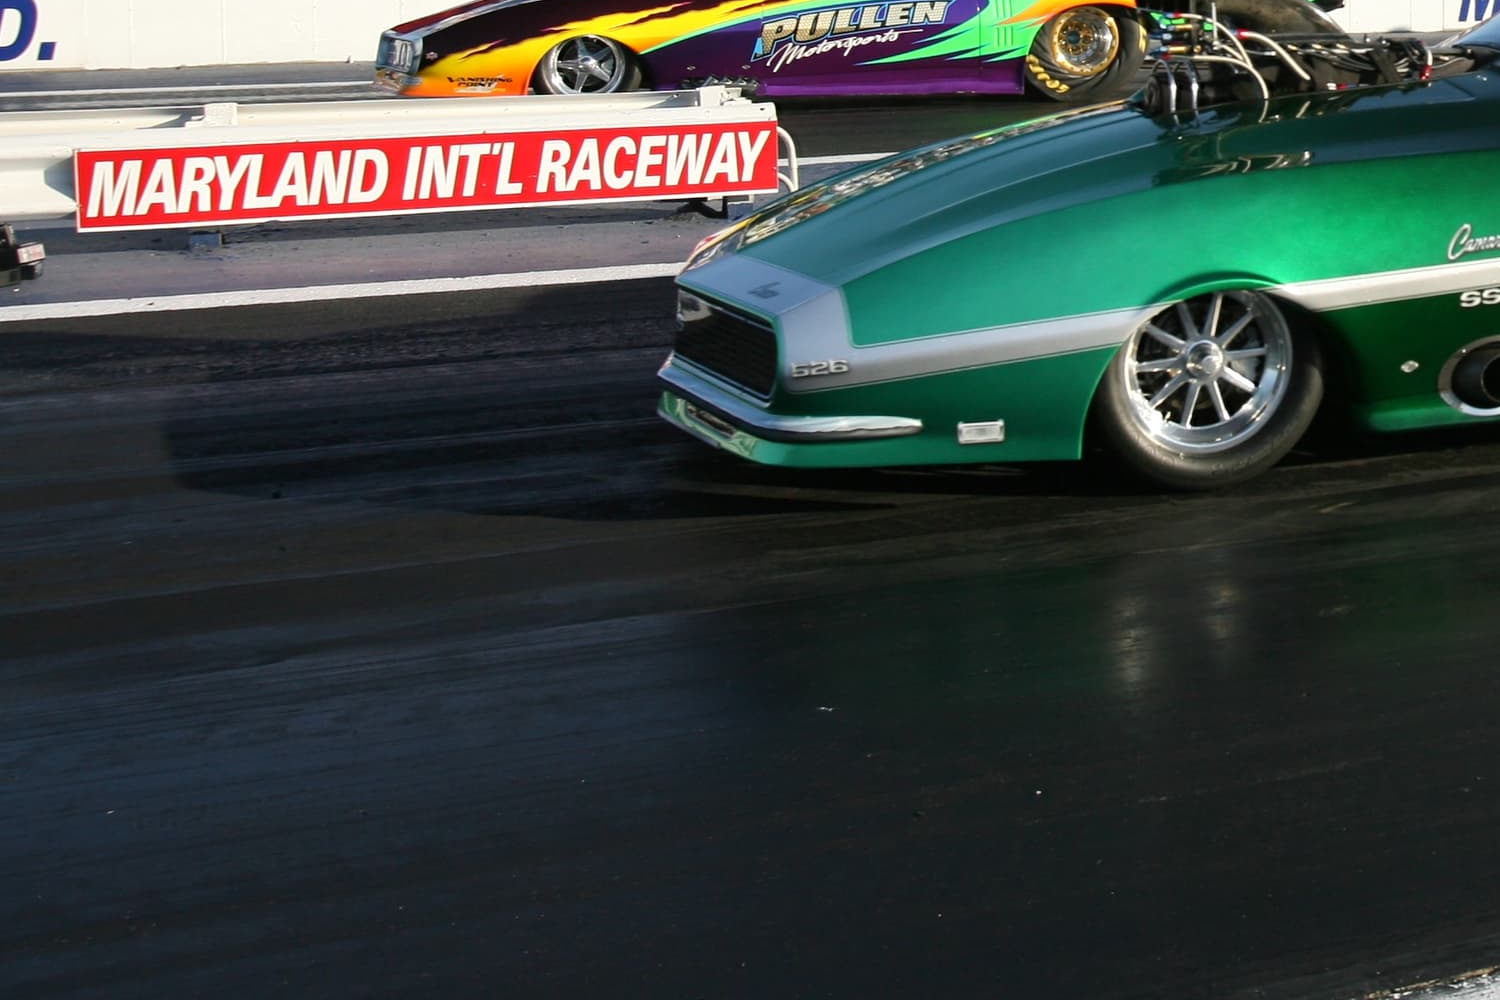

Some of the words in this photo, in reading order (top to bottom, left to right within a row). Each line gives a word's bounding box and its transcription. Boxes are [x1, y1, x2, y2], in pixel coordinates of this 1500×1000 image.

[754, 0, 950, 61] PULLEN
[766, 28, 923, 73] Motorsports
[86, 148, 390, 219] MARYLAND
[401, 141, 523, 201] INT'L
[535, 129, 771, 194] RACEWAY
[791, 359, 849, 378] 526
